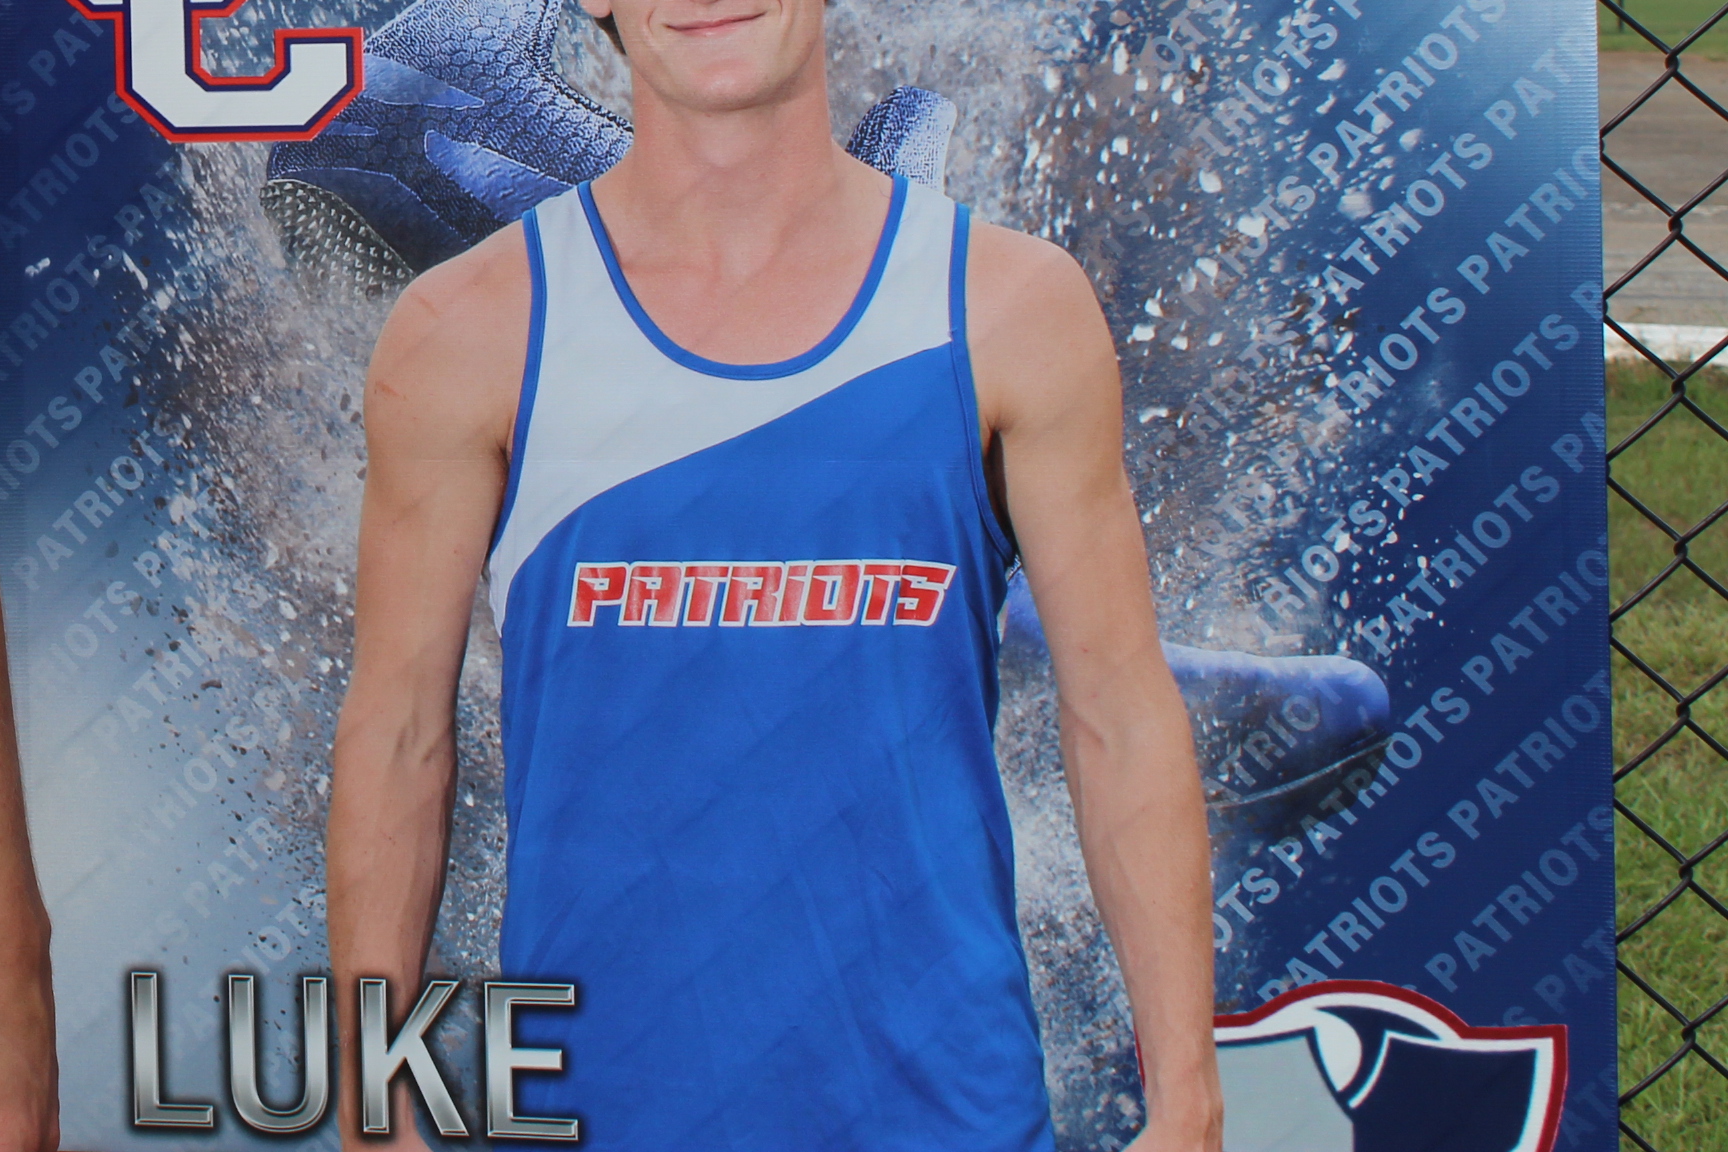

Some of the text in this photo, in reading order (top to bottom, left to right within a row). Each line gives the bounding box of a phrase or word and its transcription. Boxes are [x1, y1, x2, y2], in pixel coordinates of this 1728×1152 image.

[1377, 306, 1584, 510] PATRIOTS
[566, 559, 958, 627] PATRIOTS
[1357, 457, 1565, 660] PATRIOTS
[1272, 680, 1476, 879] PATRIOTS
[129, 970, 580, 1142] LUKE
